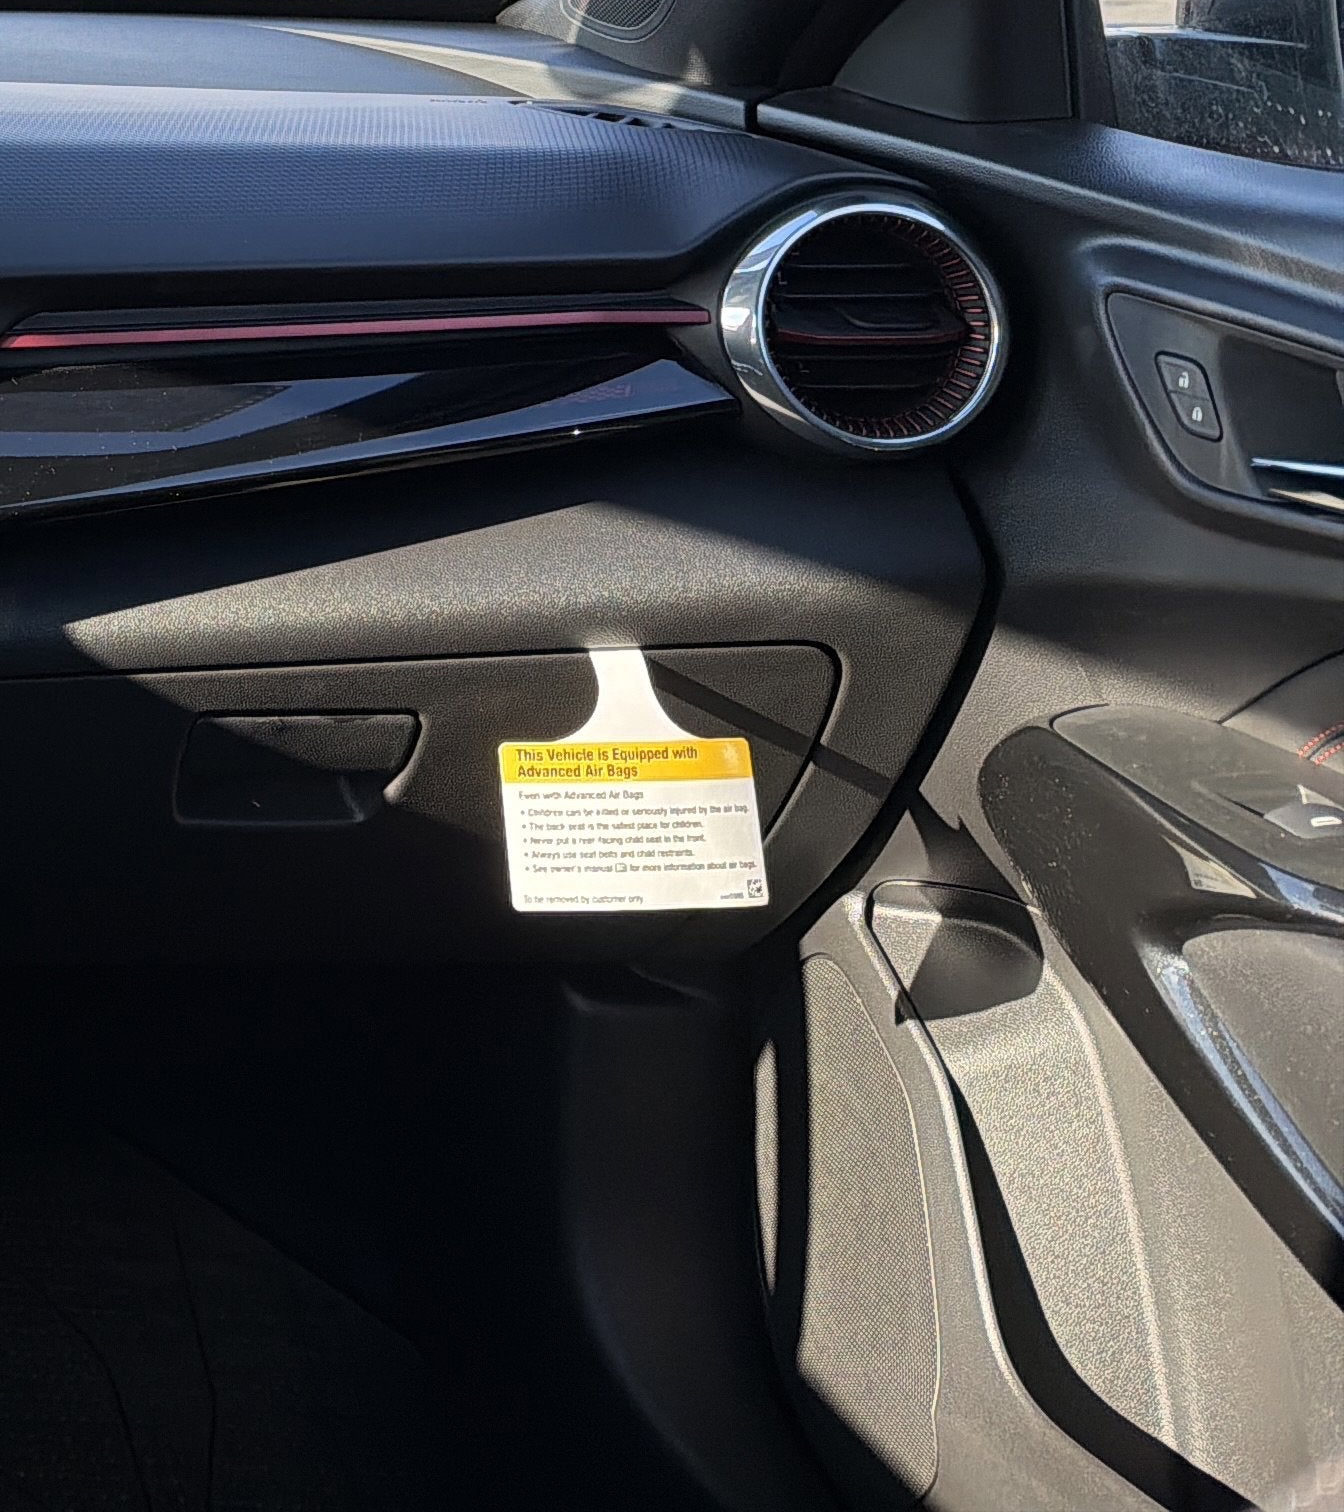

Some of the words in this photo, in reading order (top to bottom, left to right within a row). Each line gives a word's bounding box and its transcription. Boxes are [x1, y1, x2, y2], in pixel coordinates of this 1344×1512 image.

[516, 748, 543, 762] This
[548, 748, 594, 762] Vehicle
[612, 748, 668, 763] Equipped
[672, 746, 698, 759] with
[518, 765, 581, 778] Advanced
[585, 765, 605, 777] Air
[607, 764, 638, 780] Bags
[564, 791, 606, 799] Advanced
[608, 791, 620, 799] Air
[623, 791, 643, 800] Bags
[699, 807, 707, 816] by
[556, 837, 569, 845] put
[523, 895, 533, 903] To
[581, 895, 590, 905] by
